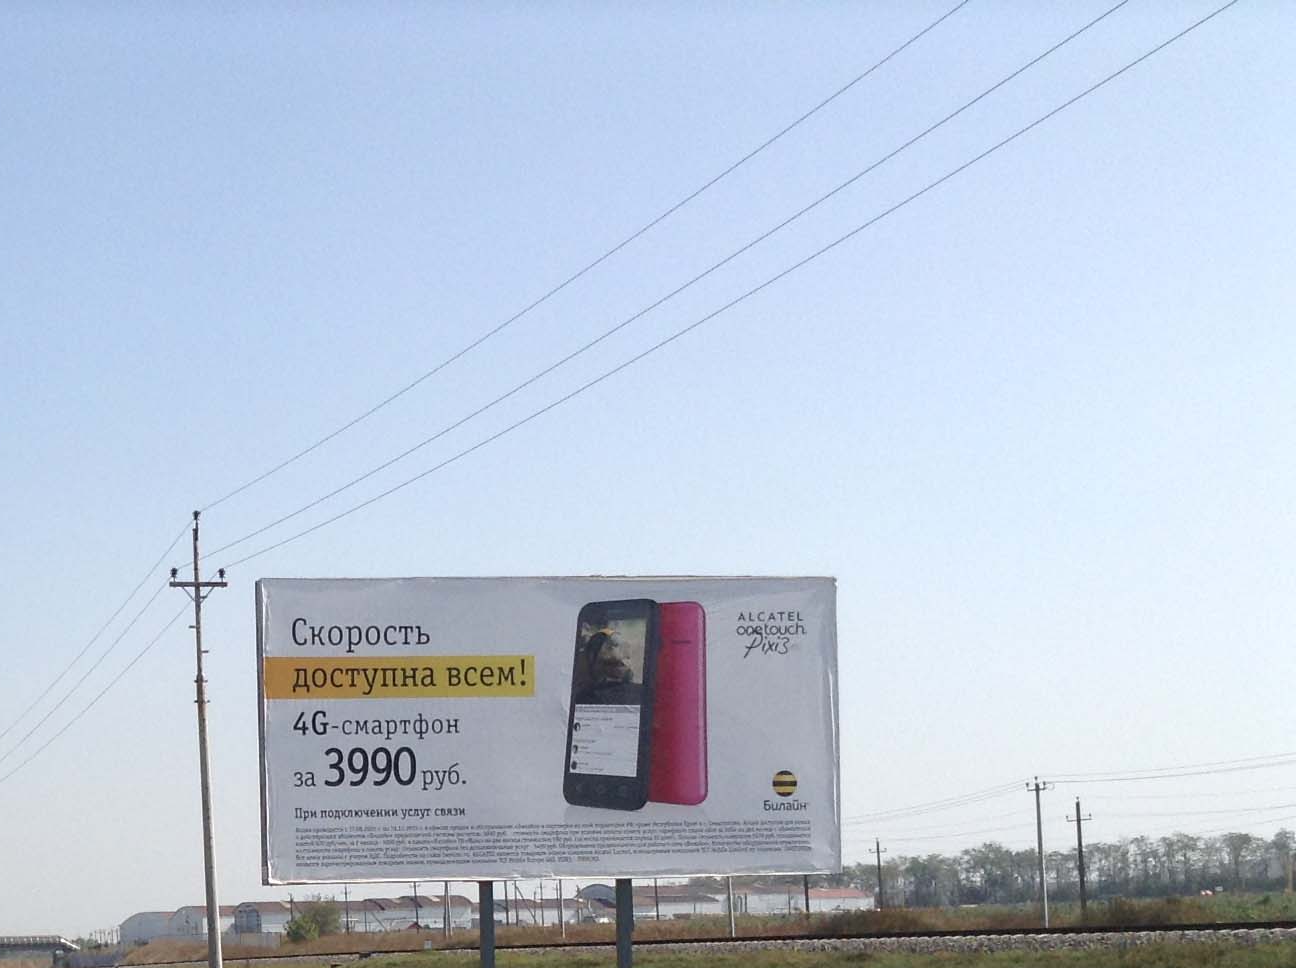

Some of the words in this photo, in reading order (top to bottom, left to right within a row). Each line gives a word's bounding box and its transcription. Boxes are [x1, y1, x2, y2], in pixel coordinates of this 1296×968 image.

[737, 611, 805, 622] ALCATEL
[291, 617, 431, 653] Скорость
[292, 667, 437, 695] доступна
[446, 658, 527, 687] всем!
[292, 710, 461, 740] 4G-смартфон
[293, 771, 317, 788] за
[323, 746, 417, 787] 3990
[420, 763, 468, 790] руб.
[294, 807, 318, 820] При
[320, 807, 399, 820] подключении
[400, 806, 432, 819] услуг
[434, 806, 466, 817] связи
